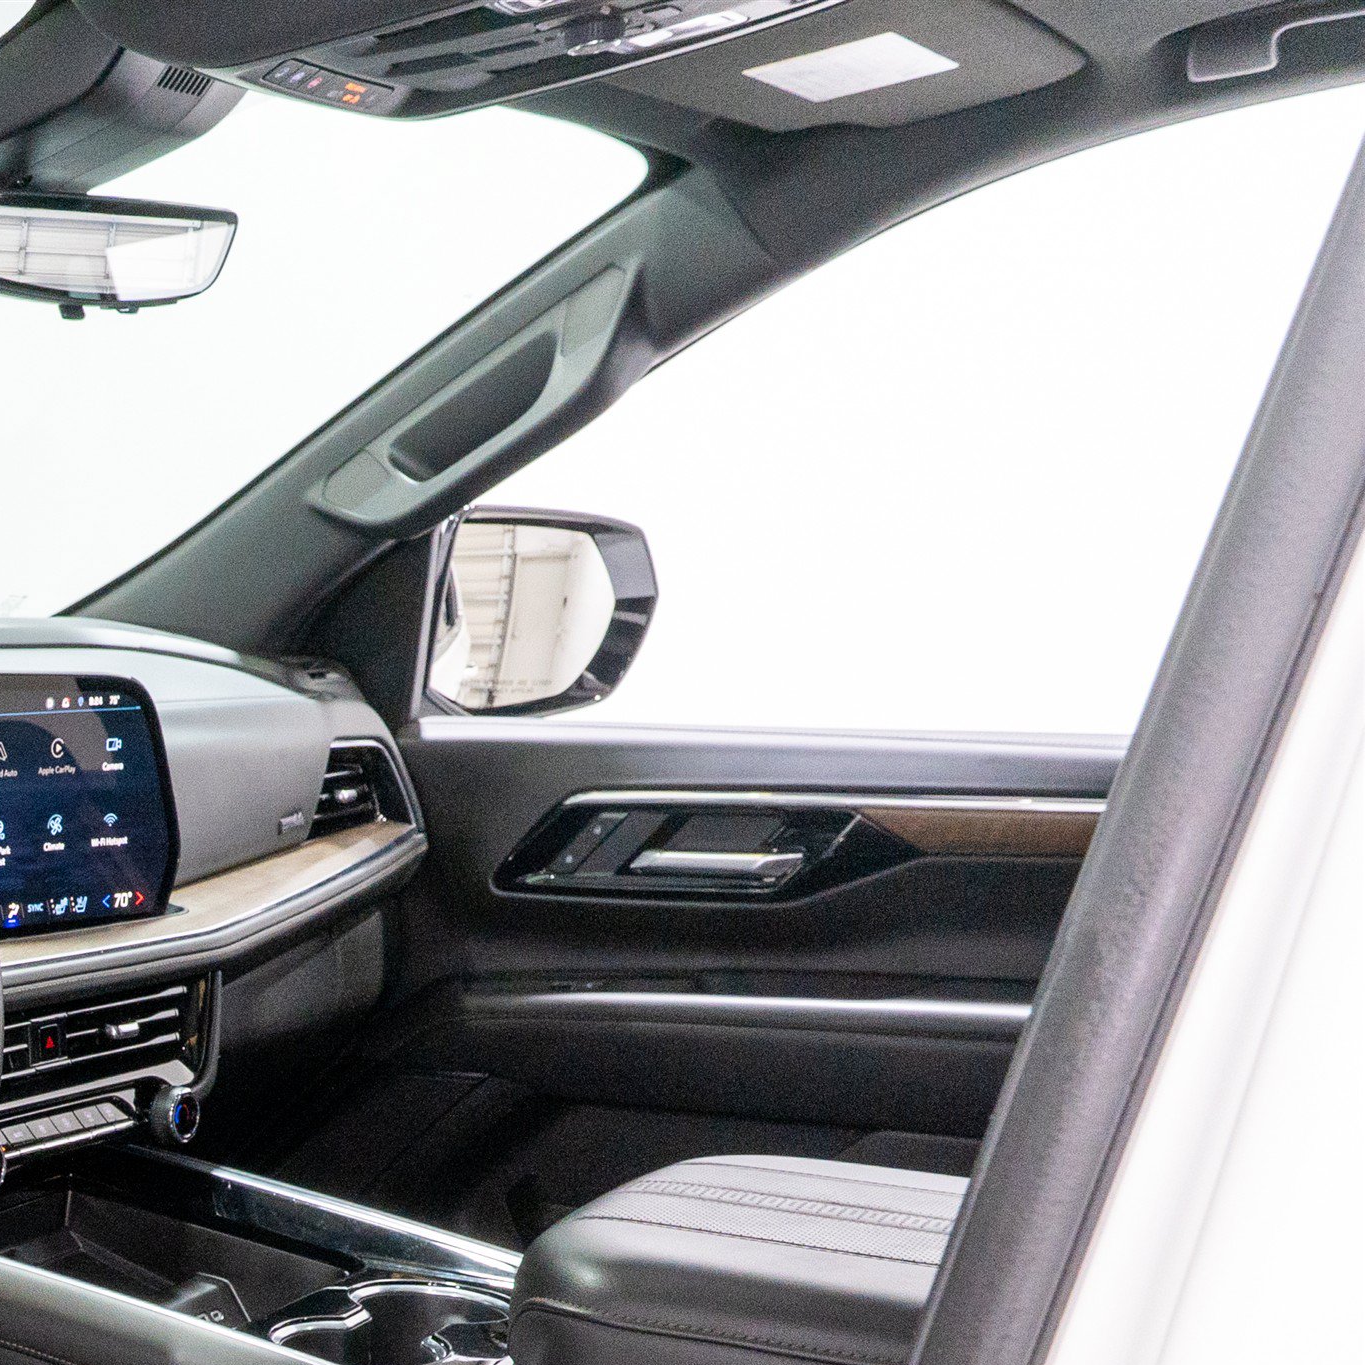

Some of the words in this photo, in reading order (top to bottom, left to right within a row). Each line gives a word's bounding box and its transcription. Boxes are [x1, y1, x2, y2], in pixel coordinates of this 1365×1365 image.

[4, 770, 18, 778] Auto
[38, 766, 54, 776] Apple
[55, 765, 76, 775] CarPlay
[27, 903, 44, 913] SYNC
